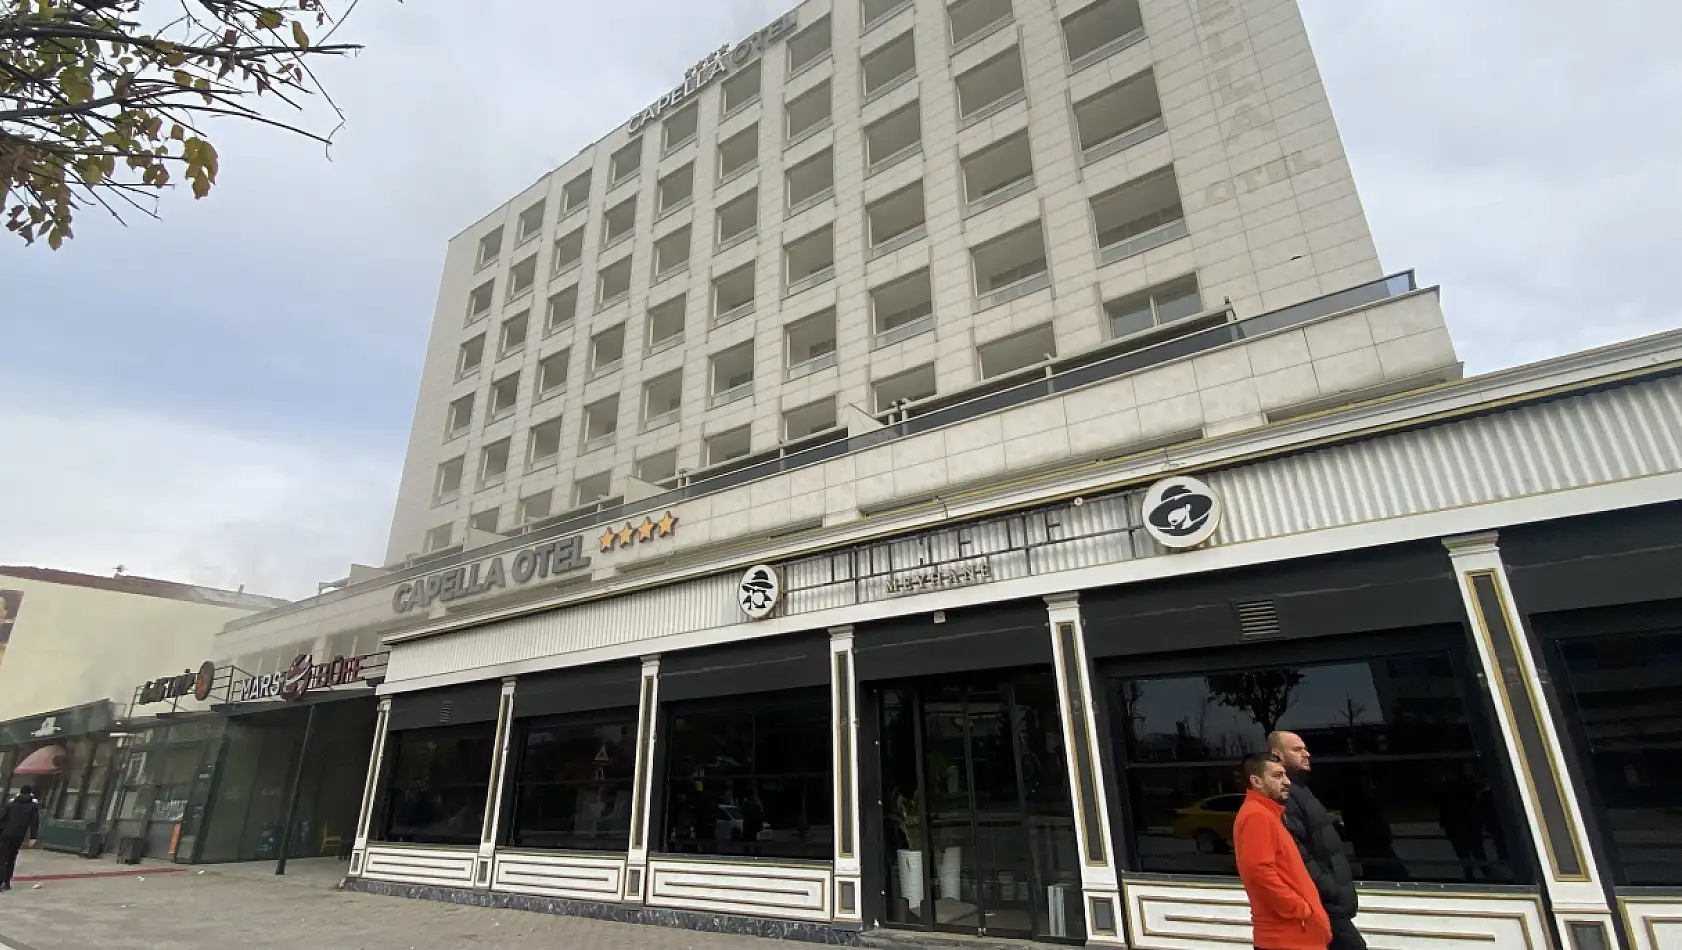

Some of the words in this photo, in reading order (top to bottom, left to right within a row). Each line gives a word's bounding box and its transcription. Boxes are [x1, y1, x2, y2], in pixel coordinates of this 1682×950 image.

[627, 57, 727, 135] CAPELLA
[731, 8, 799, 66] OTEL
[392, 557, 507, 613] CAPELLA
[512, 535, 592, 583] OTEL
[886, 563, 993, 593] MEYHANE
